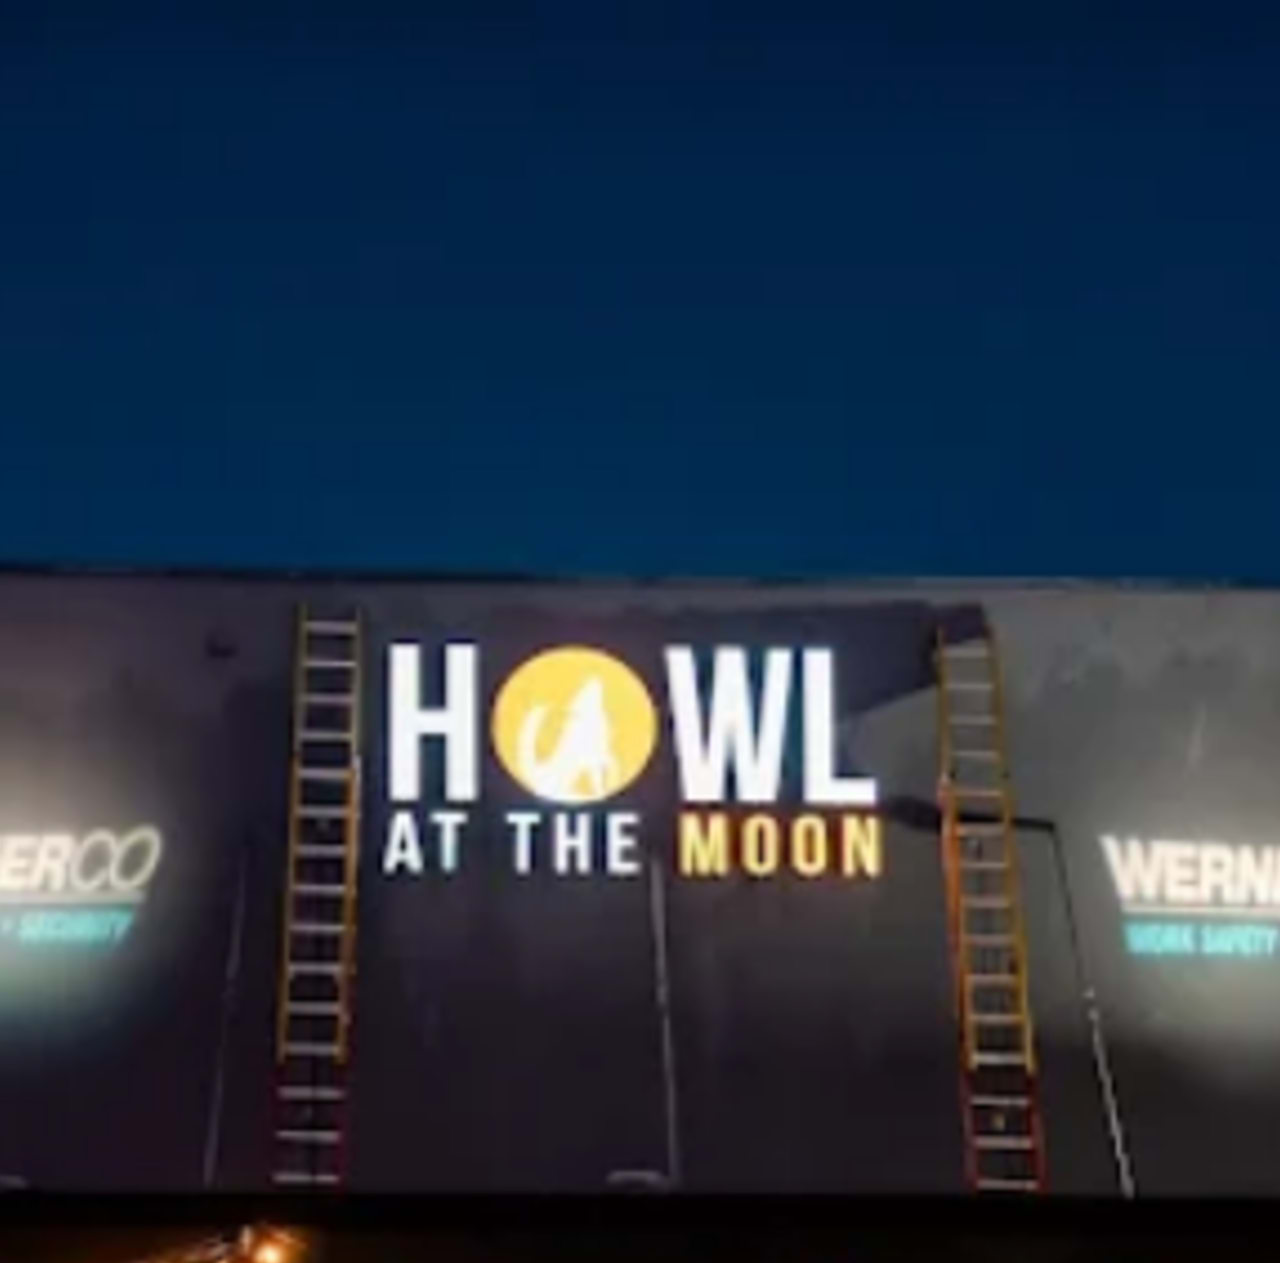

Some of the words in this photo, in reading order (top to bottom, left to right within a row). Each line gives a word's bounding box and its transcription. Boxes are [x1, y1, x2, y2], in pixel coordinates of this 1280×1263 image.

[383, 813, 468, 874] AT
[506, 813, 641, 875] THE
[678, 814, 883, 877] MOON
